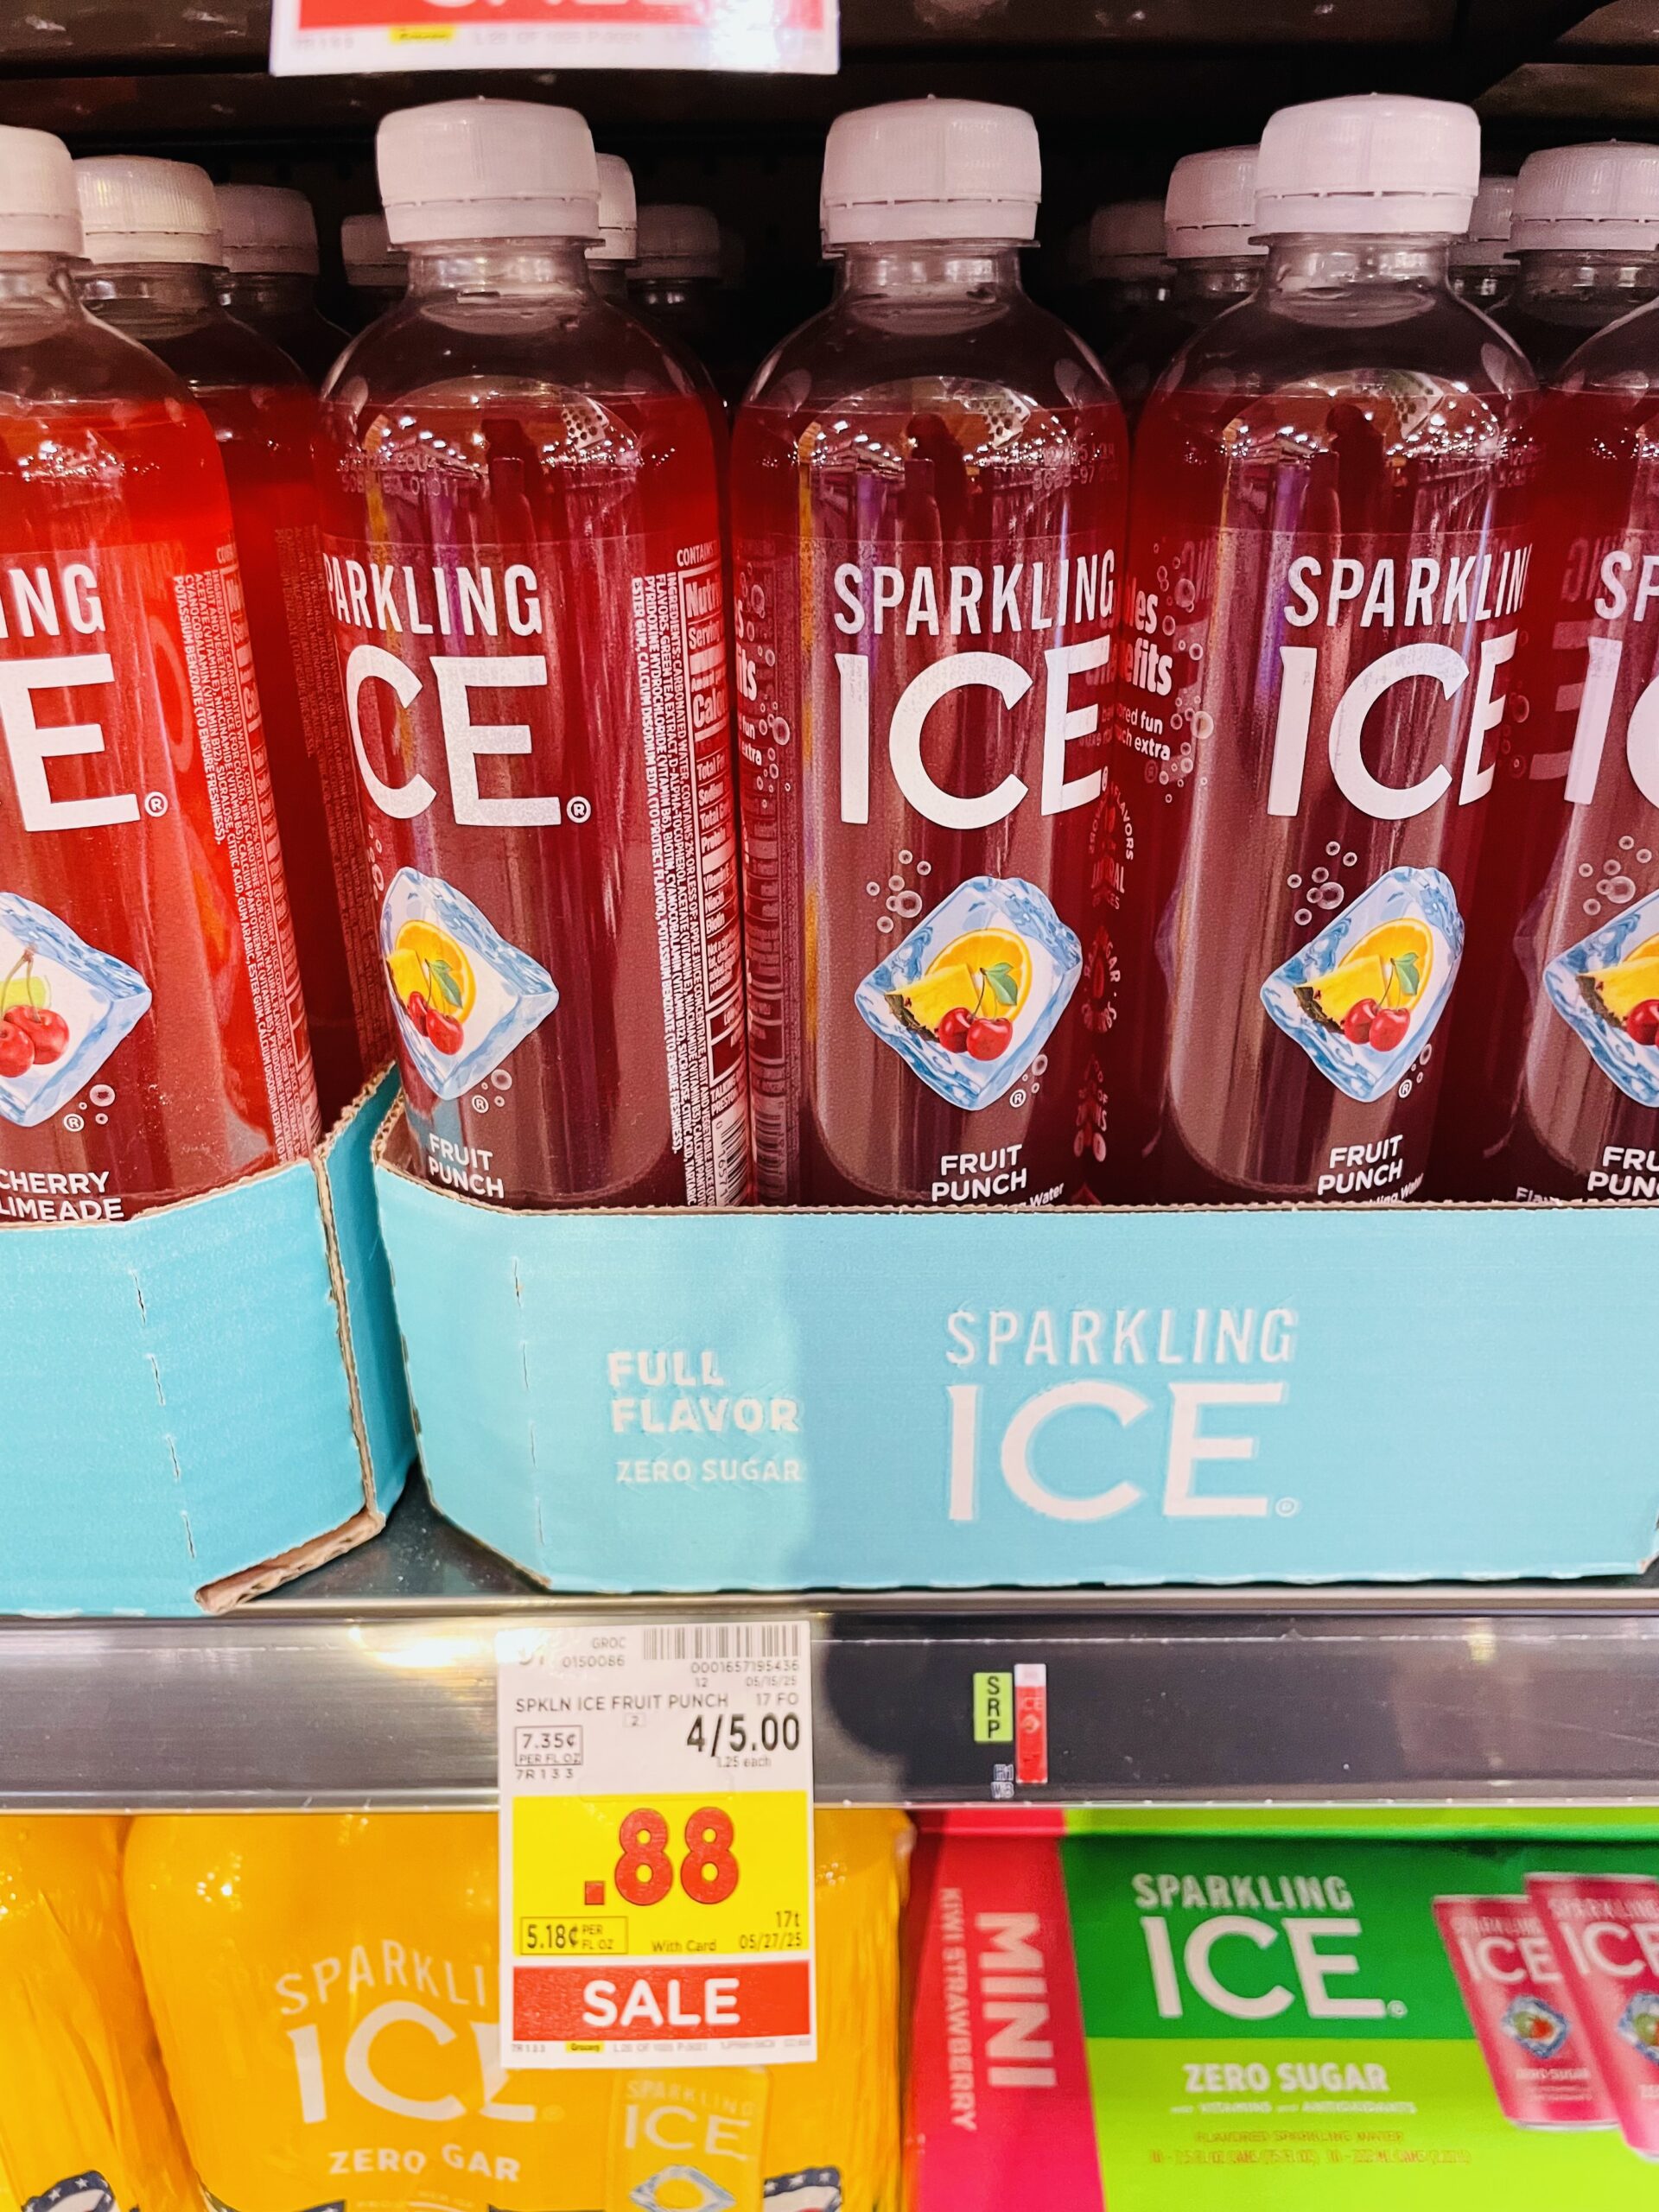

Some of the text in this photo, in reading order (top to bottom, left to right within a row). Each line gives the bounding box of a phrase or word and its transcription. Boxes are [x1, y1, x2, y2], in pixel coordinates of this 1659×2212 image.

[631, 577, 645, 617] ESTER
[834, 549, 1115, 635] SPARKLING
[1284, 543, 1533, 627] SPARKLIN
[655, 574, 669, 634] FLAVORS,
[634, 619, 648, 651] GUM,
[659, 635, 672, 677] GREEN
[637, 652, 652, 705] CALCIUM
[663, 677, 674, 702] TEA
[641, 707, 656, 764] DISODIUM
[664, 702, 677, 758] EXTRACT,
[834, 635, 1110, 830] ICE
[1141, 710, 1163, 734] fun
[1268, 628, 1518, 820] ICE
[677, 740, 690, 784] WATER,
[1135, 735, 1170, 760] extra
[645, 766, 658, 796] EDTA
[657, 754, 671, 806] (VITAMIN
[648, 798, 660, 818] (TO
[660, 808, 672, 831] B6),
[680, 785, 693, 839] CONTAINS
[649, 818, 664, 868] PROTECT
[662, 832, 675, 874] BIOTIN,
[683, 840, 694, 857] 2%
[685, 858, 696, 875] OR
[653, 869, 667, 919] FLAVOR),
[686, 877, 697, 902] LESS
[677, 886, 689, 931] ACETATE
[688, 903, 698, 919] OF:
[690, 921, 700, 953] APPLE
[680, 932, 692, 978] (VITAMIN
[691, 953, 702, 983] JUICE
[671, 972, 684, 1019] (VITAMIN
[683, 979, 693, 995] E),
[661, 980, 675, 1033] BENZOATE
[664, 1033, 676, 1051] (TO
[675, 1020, 686, 1044] B12),
[666, 1054, 678, 1090] ENSURE
[688, 1060, 700, 1106] (VITAMIN
[697, 1058, 708, 1084] FRUIT
[699, 1086, 709, 1108] AND
[680, 1103, 692, 1135] CITRIC
[690, 1107, 701, 1126] B3),
[429, 1133, 493, 1171] FRUIT
[683, 1135, 694, 1161] ACID,
[692, 1126, 703, 1167] CALCIUM
[941, 1144, 1022, 1176] FRUIT
[1329, 1134, 1403, 1169] FRUIT
[0, 1168, 110, 1194] CHERRY
[429, 1157, 504, 1199] PUNCH
[683, 1161, 696, 1205] TARTARIC
[703, 1161, 714, 1186] JUICE
[931, 1167, 1027, 1202] PUNCH
[1317, 1158, 1403, 1196] PUNCH
[1587, 1171, 1659, 1198] PUN
[0, 1195, 124, 1221] LIMEADE
[1029, 1183, 1065, 1207] Water
[947, 1307, 1299, 1365] SPARKLING
[607, 1351, 725, 1387] FULL
[611, 1397, 800, 1433] FLAVOR
[947, 1381, 1285, 1522] ICE
[616, 1459, 801, 1483] ZERO SUGAR
[592, 1637, 626, 1649] GROC
[563, 1656, 625, 1668] 0150086
[516, 1698, 571, 1713] SPKLN
[578, 1696, 605, 1711] ICE
[612, 1694, 662, 1710] FRUIT
[669, 1693, 728, 1707] PUNCH
[756, 1694, 770, 1707] 17
[687, 1712, 800, 1758] 4/5.00
[519, 1752, 581, 1764] PER FL OZ
[743, 1756, 772, 1768] each
[584, 1806, 740, 1906] .88
[1132, 1873, 1353, 1910] SPARKLING
[526, 1923, 578, 1949] 5.18¢
[582, 1924, 603, 1936] PER
[582, 1939, 614, 1950] FL OZ
[652, 1939, 716, 1953] With Card
[739, 1933, 803, 1951] 05/27/25
[276, 1938, 486, 2015] SPARKLI
[1141, 1915, 1388, 2020] ICE
[1458, 1936, 1562, 1984] ICE
[582, 1977, 741, 2028] SALE
[975, 1912, 1058, 2088] MINI
[942, 1947, 977, 2131] STRAWBERRY
[1183, 2062, 1389, 2092] ZERO SUGAR
[626, 2104, 751, 2161] ICE
[328, 2146, 427, 2176] ZERO
